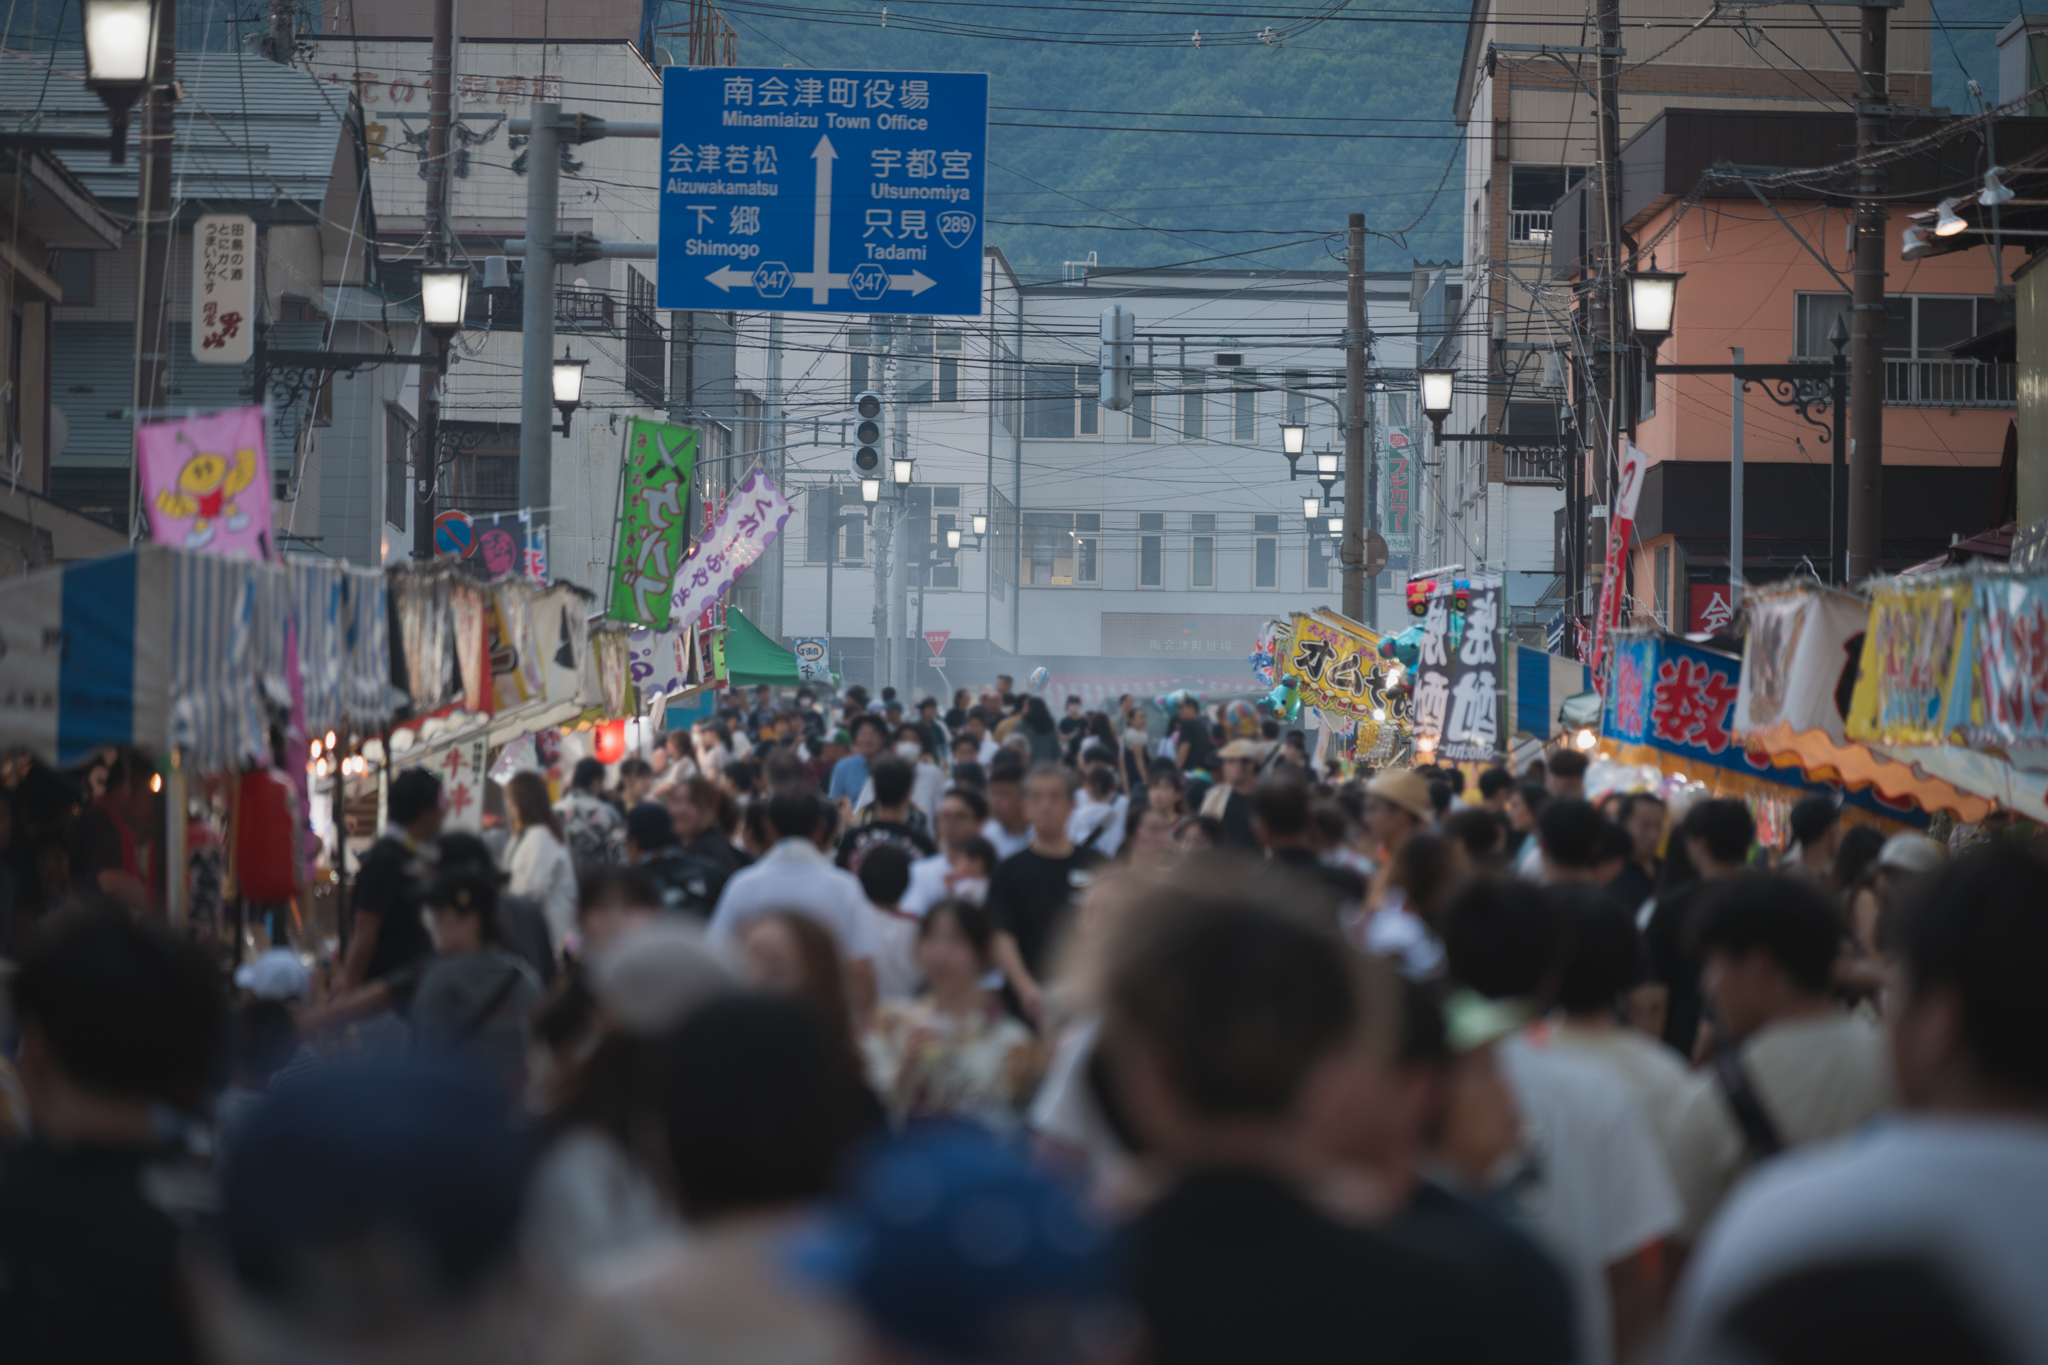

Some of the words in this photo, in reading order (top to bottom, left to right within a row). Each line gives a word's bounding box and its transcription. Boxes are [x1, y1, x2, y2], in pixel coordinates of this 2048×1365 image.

[723, 76, 930, 110] 南会津町役場
[722, 110, 819, 129] Minamiaizu
[825, 113, 871, 129] Town
[877, 113, 929, 131] Office
[668, 143, 778, 176] 会津若松
[870, 148, 972, 180] 宇都宮
[666, 178, 779, 196] Aizuwakamatsu
[870, 182, 970, 203] Utsunomiya
[685, 205, 761, 236] 下郷
[863, 209, 928, 240] 只見
[941, 215, 971, 234] 289
[204, 223, 217, 294] うまいんです
[218, 223, 230, 281] とにかく
[231, 223, 244, 281] 田島の酒
[685, 239, 760, 260] Shimogo
[864, 243, 927, 261] Tadami
[758, 270, 788, 289] 347
[855, 272, 884, 291] 347
[1390, 458, 1408, 532] フジカラー
[928, 635, 946, 643] 止まれ
[1150, 639, 1232, 652] 南会津町役場
